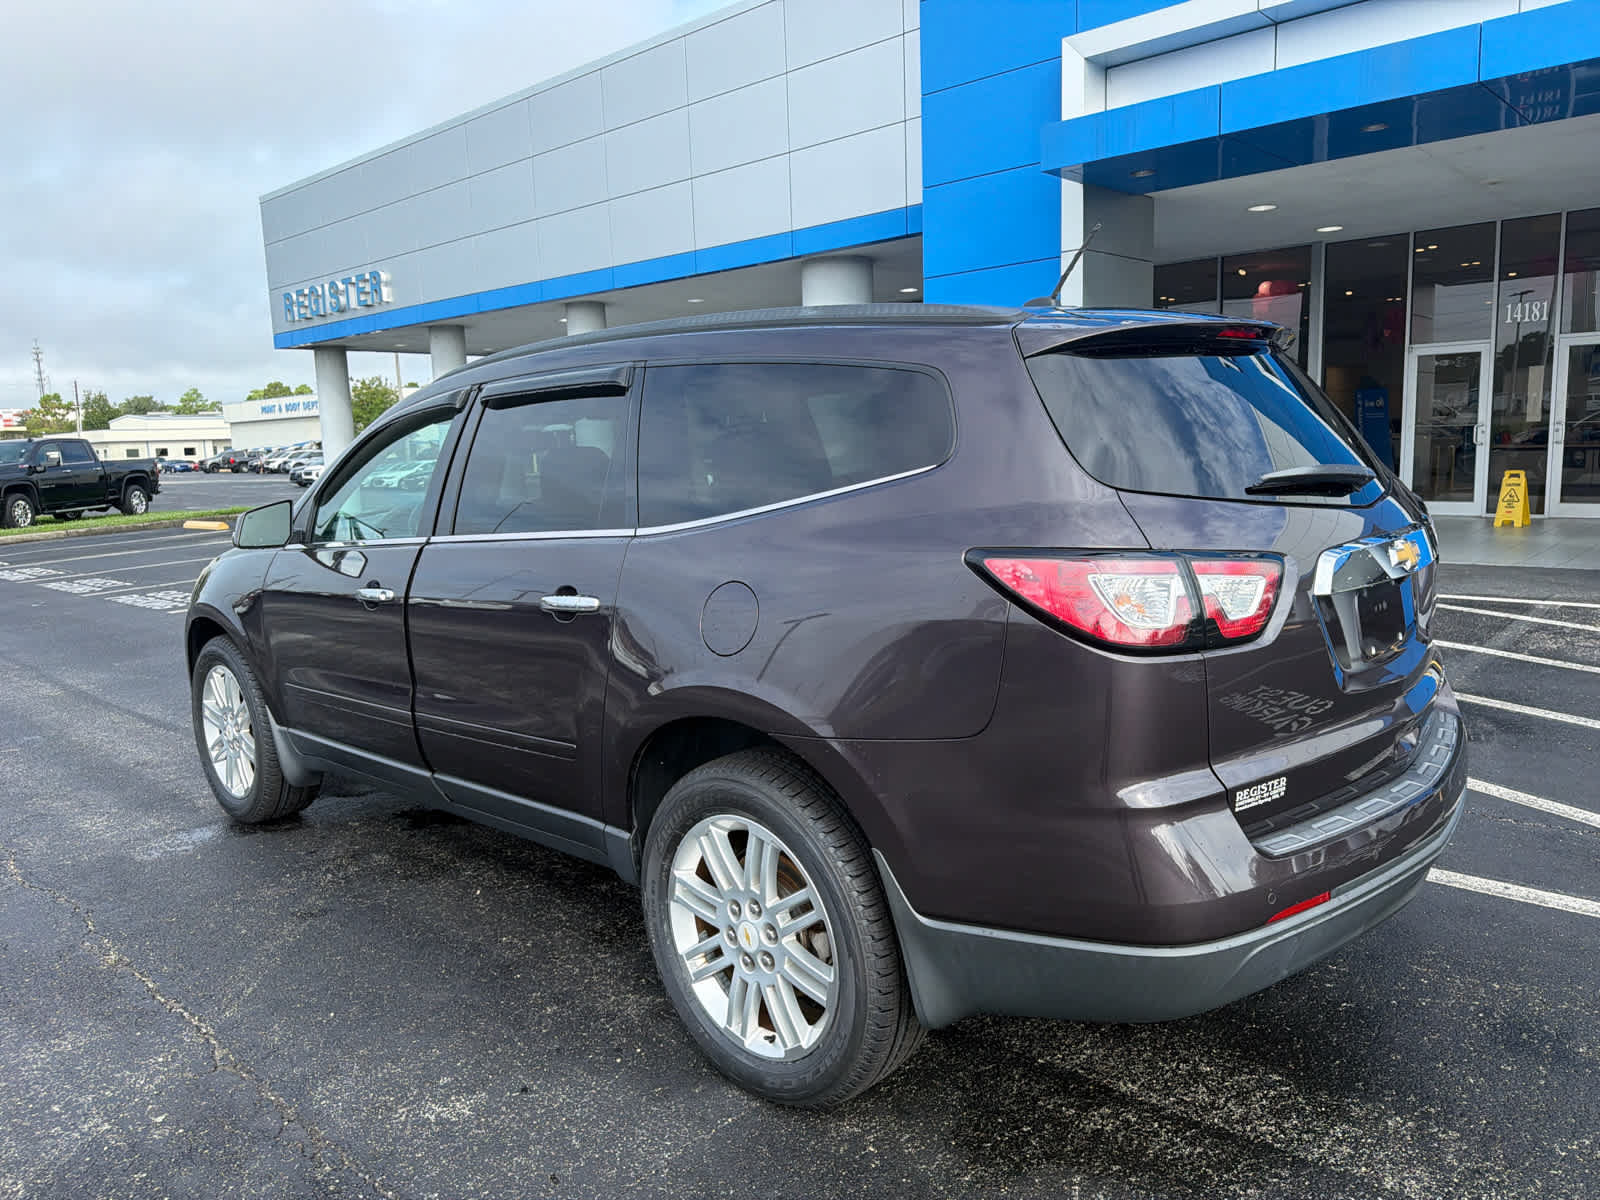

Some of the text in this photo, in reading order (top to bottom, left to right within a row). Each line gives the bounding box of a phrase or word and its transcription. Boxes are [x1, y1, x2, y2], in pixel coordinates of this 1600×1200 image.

[283, 271, 384, 321] REGISTER
[1504, 301, 1548, 323] 14181
[1236, 777, 1287, 801] REGISTER
